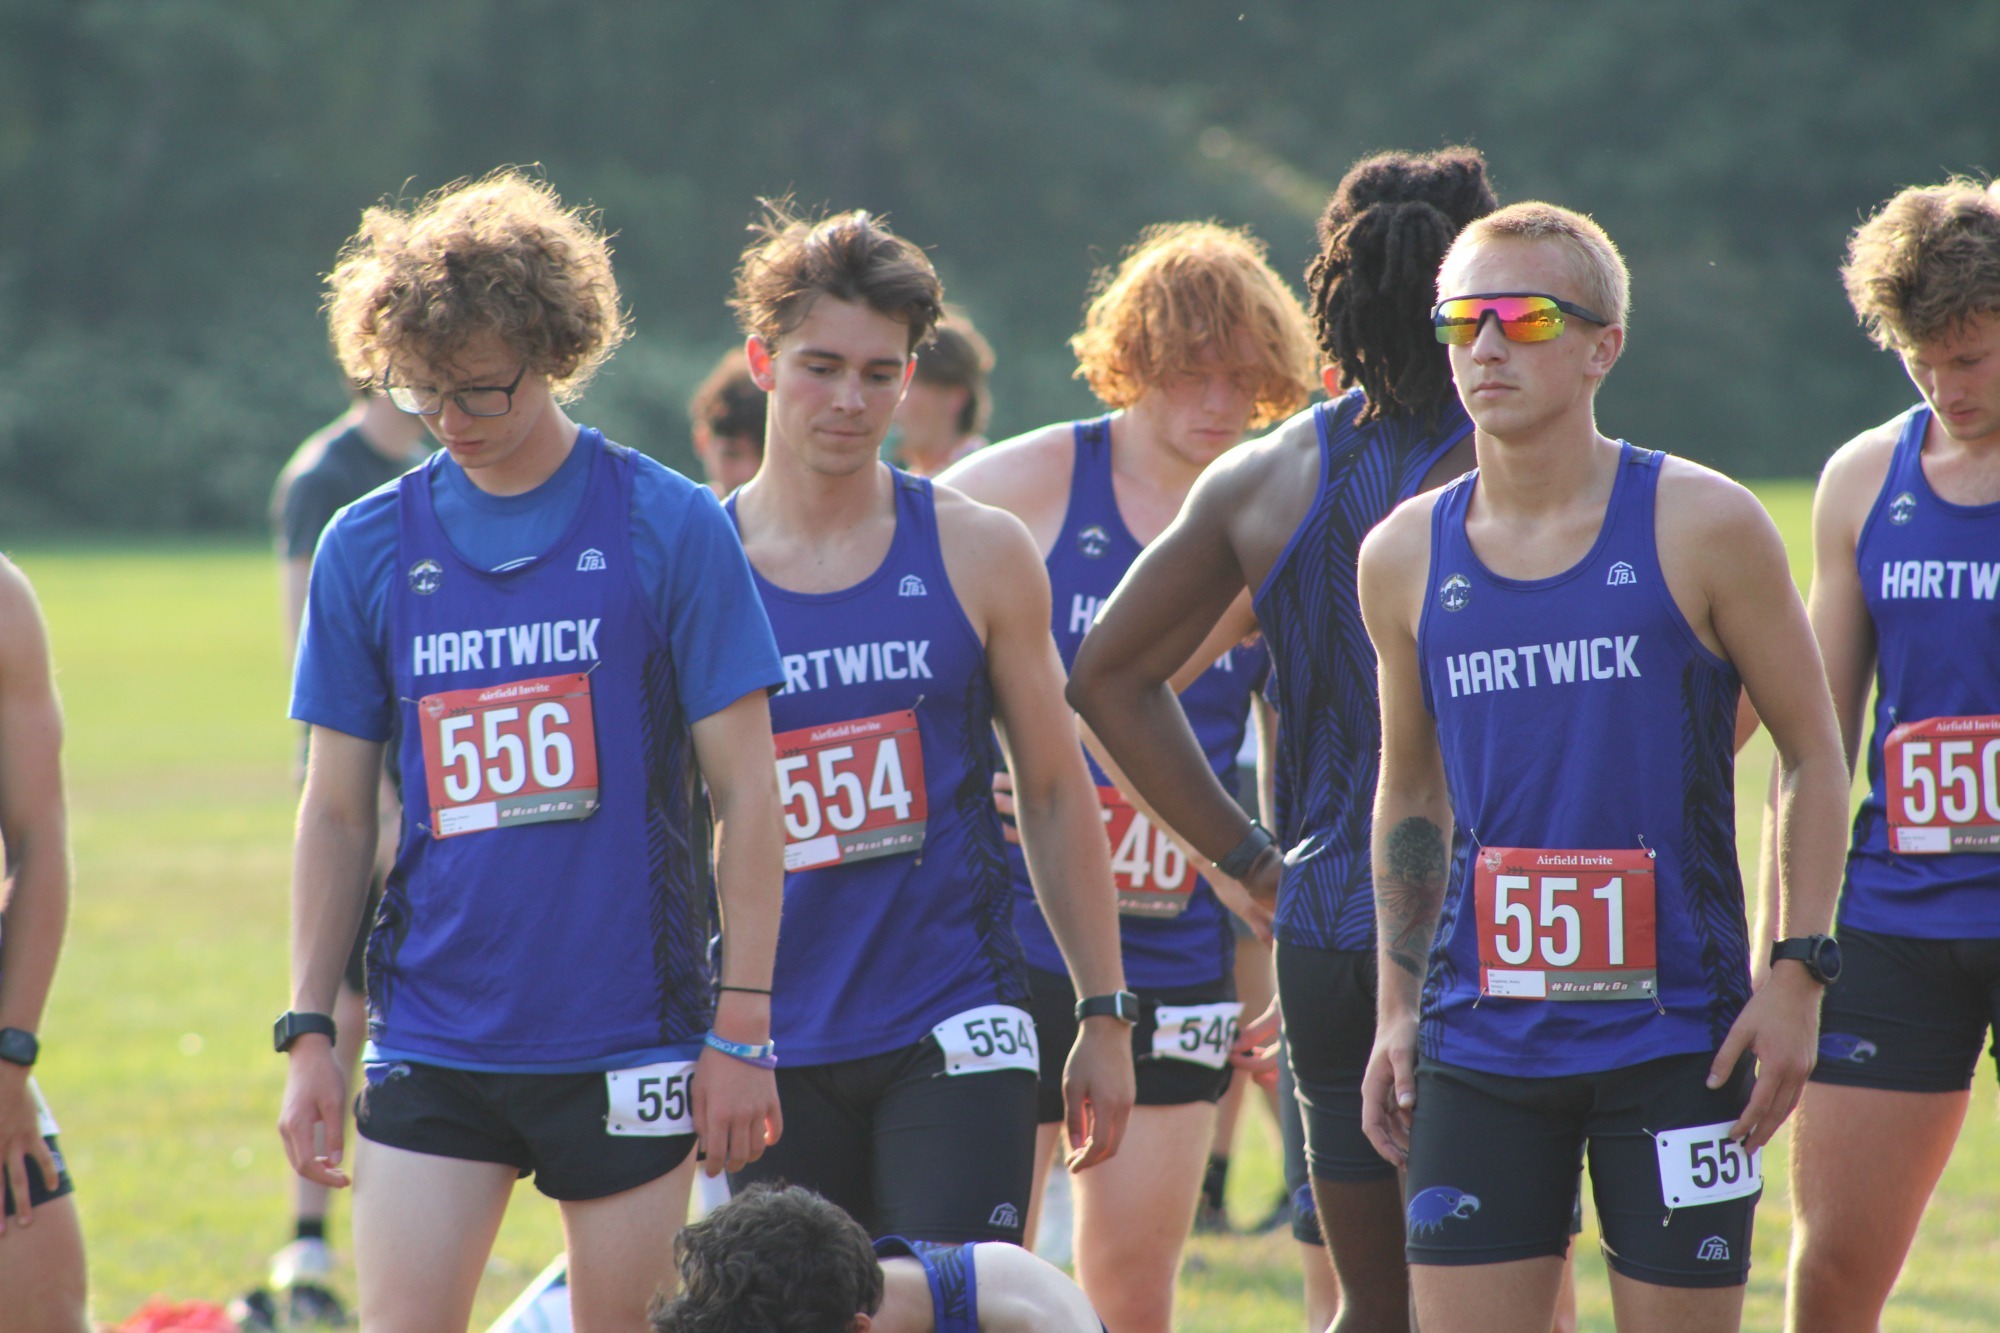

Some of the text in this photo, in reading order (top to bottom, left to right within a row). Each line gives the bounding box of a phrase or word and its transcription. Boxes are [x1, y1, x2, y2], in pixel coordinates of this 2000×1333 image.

[1882, 560, 2000, 600] HARTW
[413, 618, 600, 676] HARTWICK
[775, 640, 933, 696] RTWICK
[1446, 635, 1641, 698] HARTWICK
[478, 684, 550, 701] Airfield Invite
[439, 702, 574, 802] 556
[810, 721, 881, 741] Airfield Invite
[1936, 720, 1973, 732] Airfield
[775, 738, 912, 839] 554
[1101, 808, 1187, 891] 46
[1536, 854, 1613, 865] Airfield Invite
[1495, 875, 1624, 967] 551
[963, 1017, 1034, 1058] 554
[637, 1072, 695, 1122] 55
